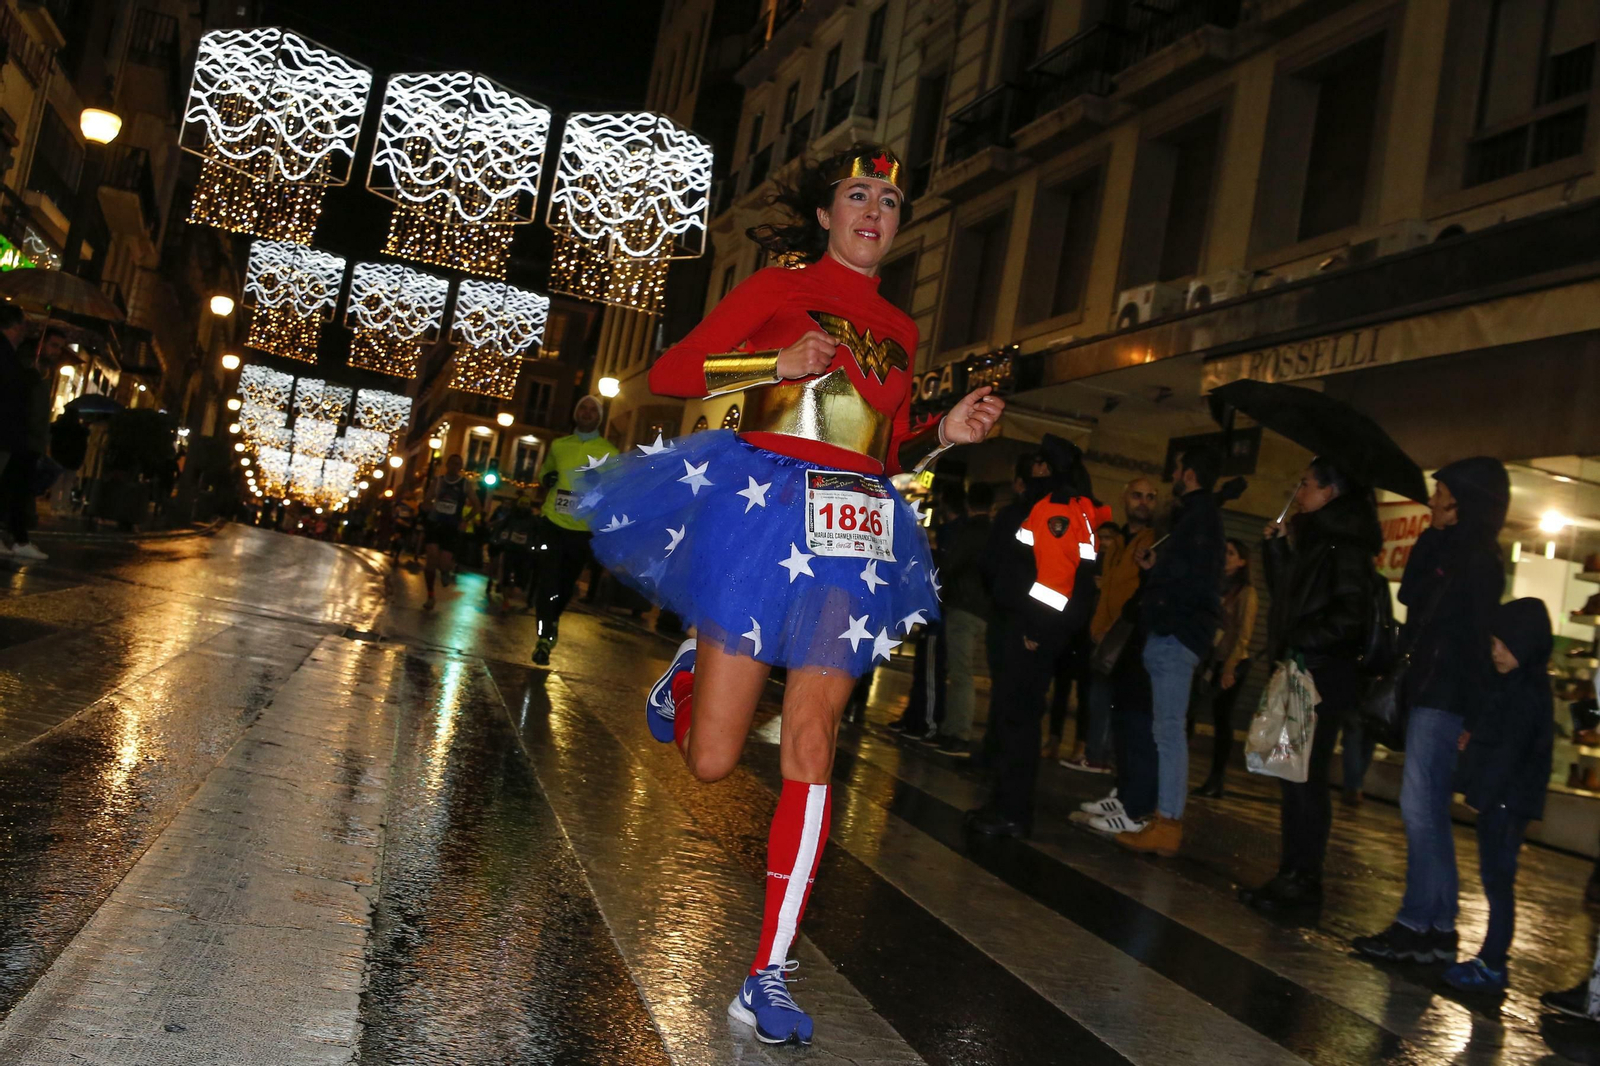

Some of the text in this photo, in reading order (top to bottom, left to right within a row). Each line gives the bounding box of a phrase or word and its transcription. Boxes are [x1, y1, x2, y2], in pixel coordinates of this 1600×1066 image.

[1249, 331, 1382, 379] ROSSELLI
[819, 503, 883, 537] 1826
[835, 532, 853, 540] CARMEN
